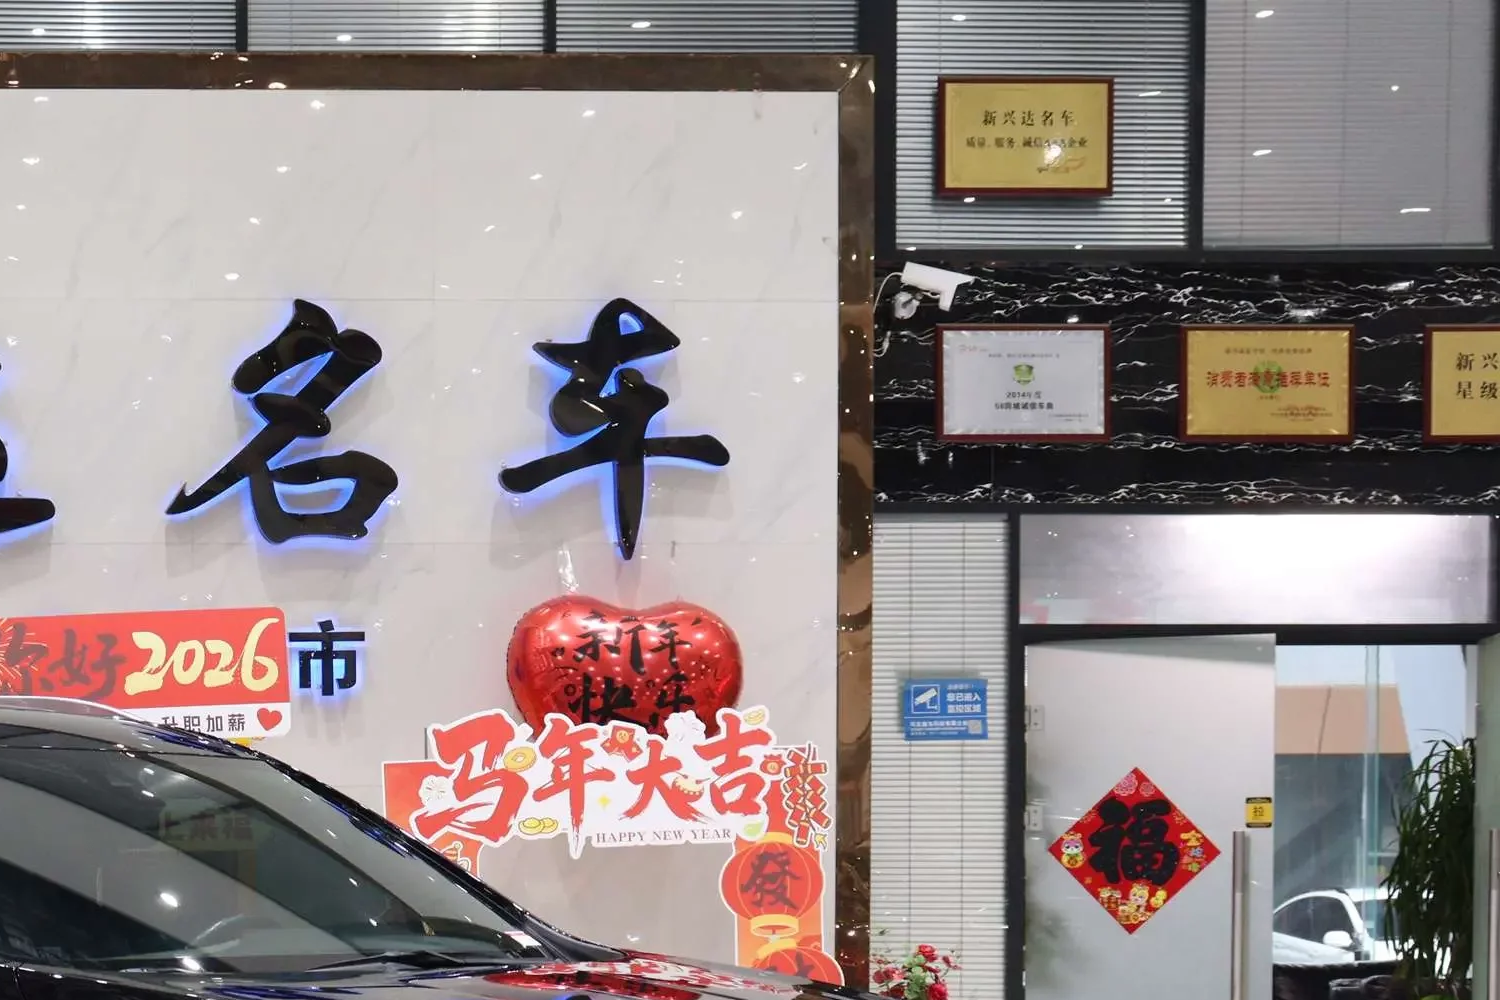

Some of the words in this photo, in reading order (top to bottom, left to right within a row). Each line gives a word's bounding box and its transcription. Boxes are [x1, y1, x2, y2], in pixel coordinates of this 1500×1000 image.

[981, 110, 1074, 126] 新兴达名车
[1456, 381, 1498, 400] 星级
[415, 712, 772, 845] 马年大吉
[595, 831, 646, 844] HAPPY
[652, 829, 684, 841] NEW
[690, 828, 731, 840] YEAR
[1088, 797, 1180, 886] 福
